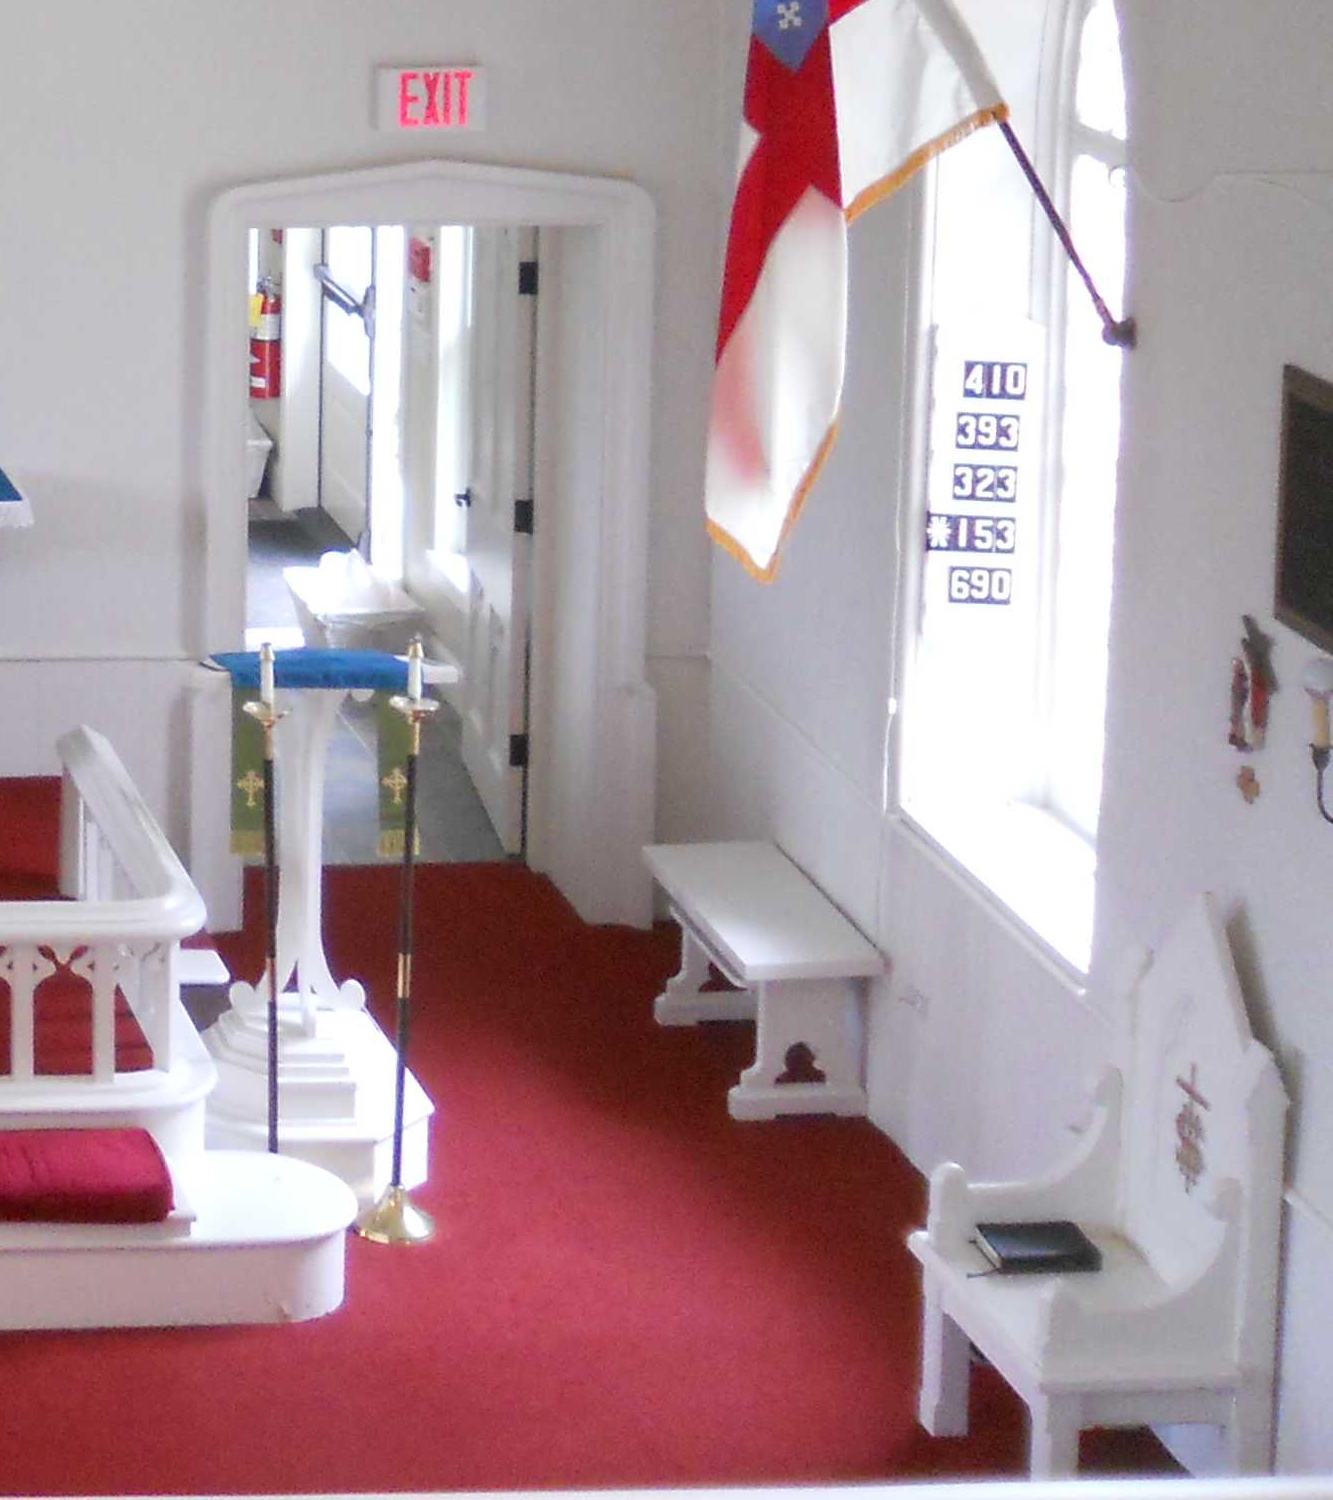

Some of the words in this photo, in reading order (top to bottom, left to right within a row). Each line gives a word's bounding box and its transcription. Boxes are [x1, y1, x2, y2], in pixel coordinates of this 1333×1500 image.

[399, 71, 472, 127] EXIT
[965, 364, 1026, 396] 410
[957, 415, 1019, 447] 393
[953, 466, 1017, 499] 323
[950, 568, 1011, 601] 690
